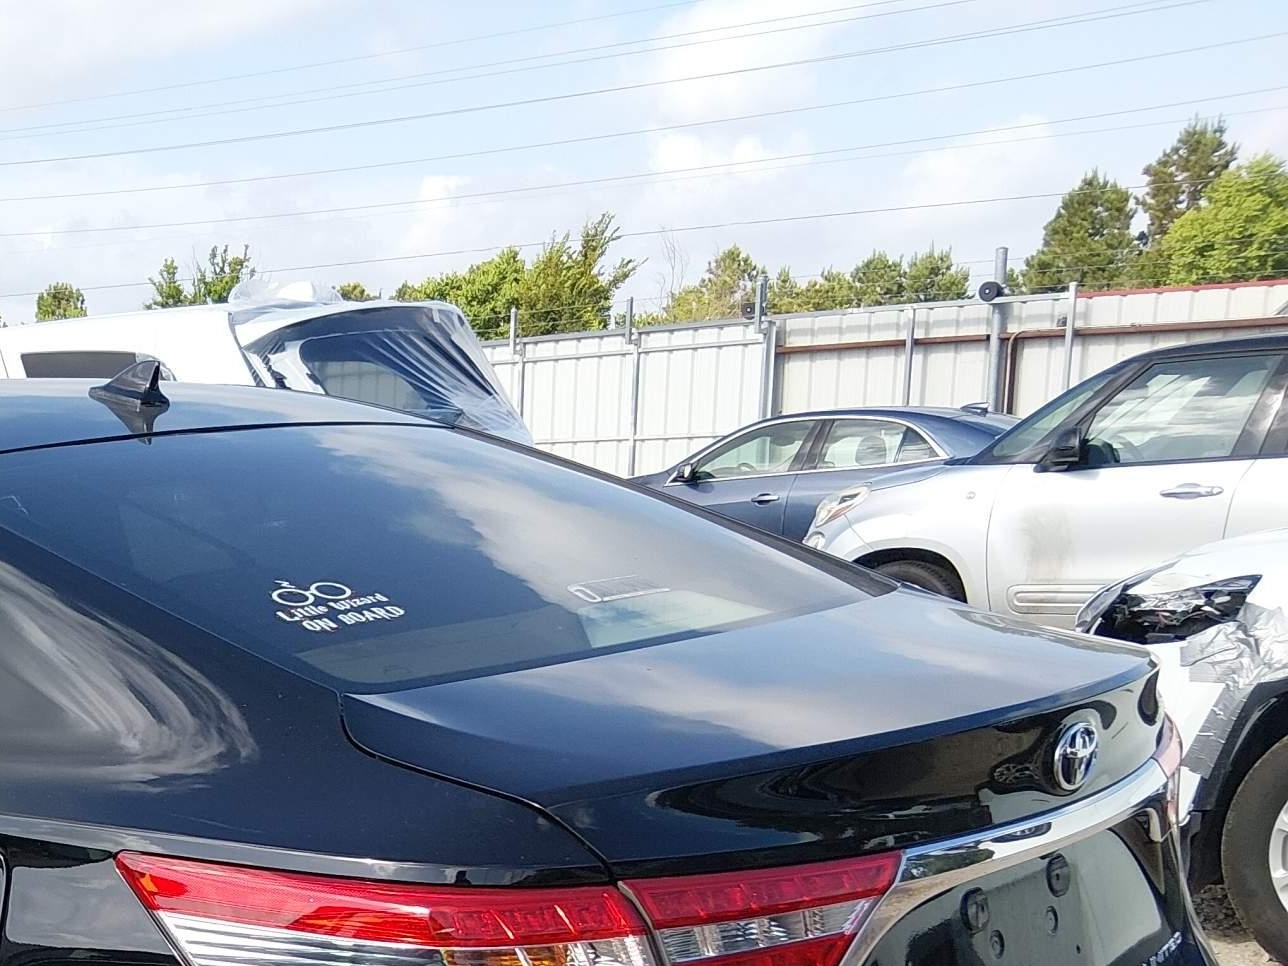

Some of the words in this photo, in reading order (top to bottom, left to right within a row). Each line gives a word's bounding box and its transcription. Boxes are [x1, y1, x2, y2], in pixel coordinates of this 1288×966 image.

[275, 604, 329, 622] Little
[327, 592, 390, 611] Wizard
[301, 617, 339, 633] ON
[337, 605, 406, 625] BOARD
